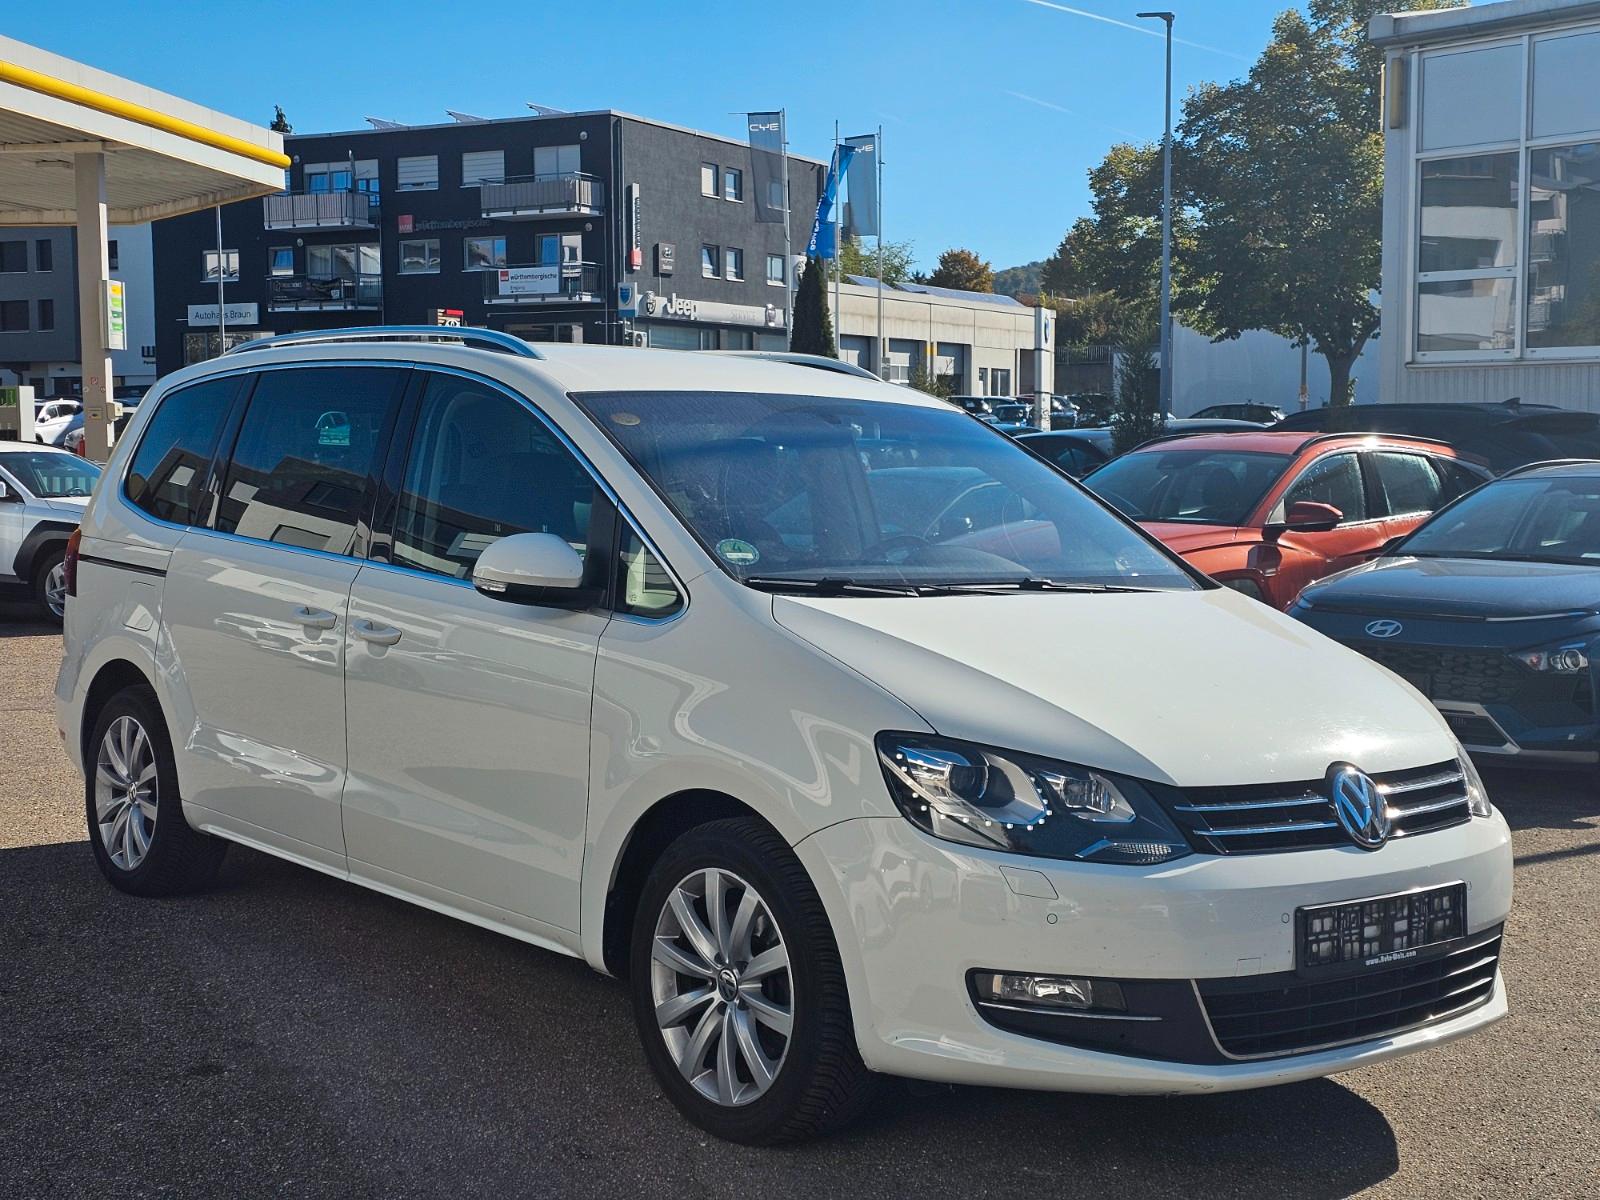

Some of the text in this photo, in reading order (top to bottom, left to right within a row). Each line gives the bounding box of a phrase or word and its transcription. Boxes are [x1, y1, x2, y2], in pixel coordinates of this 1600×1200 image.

[194, 310, 252, 320] Autohas Braun
[666, 292, 697, 320] Jeep
